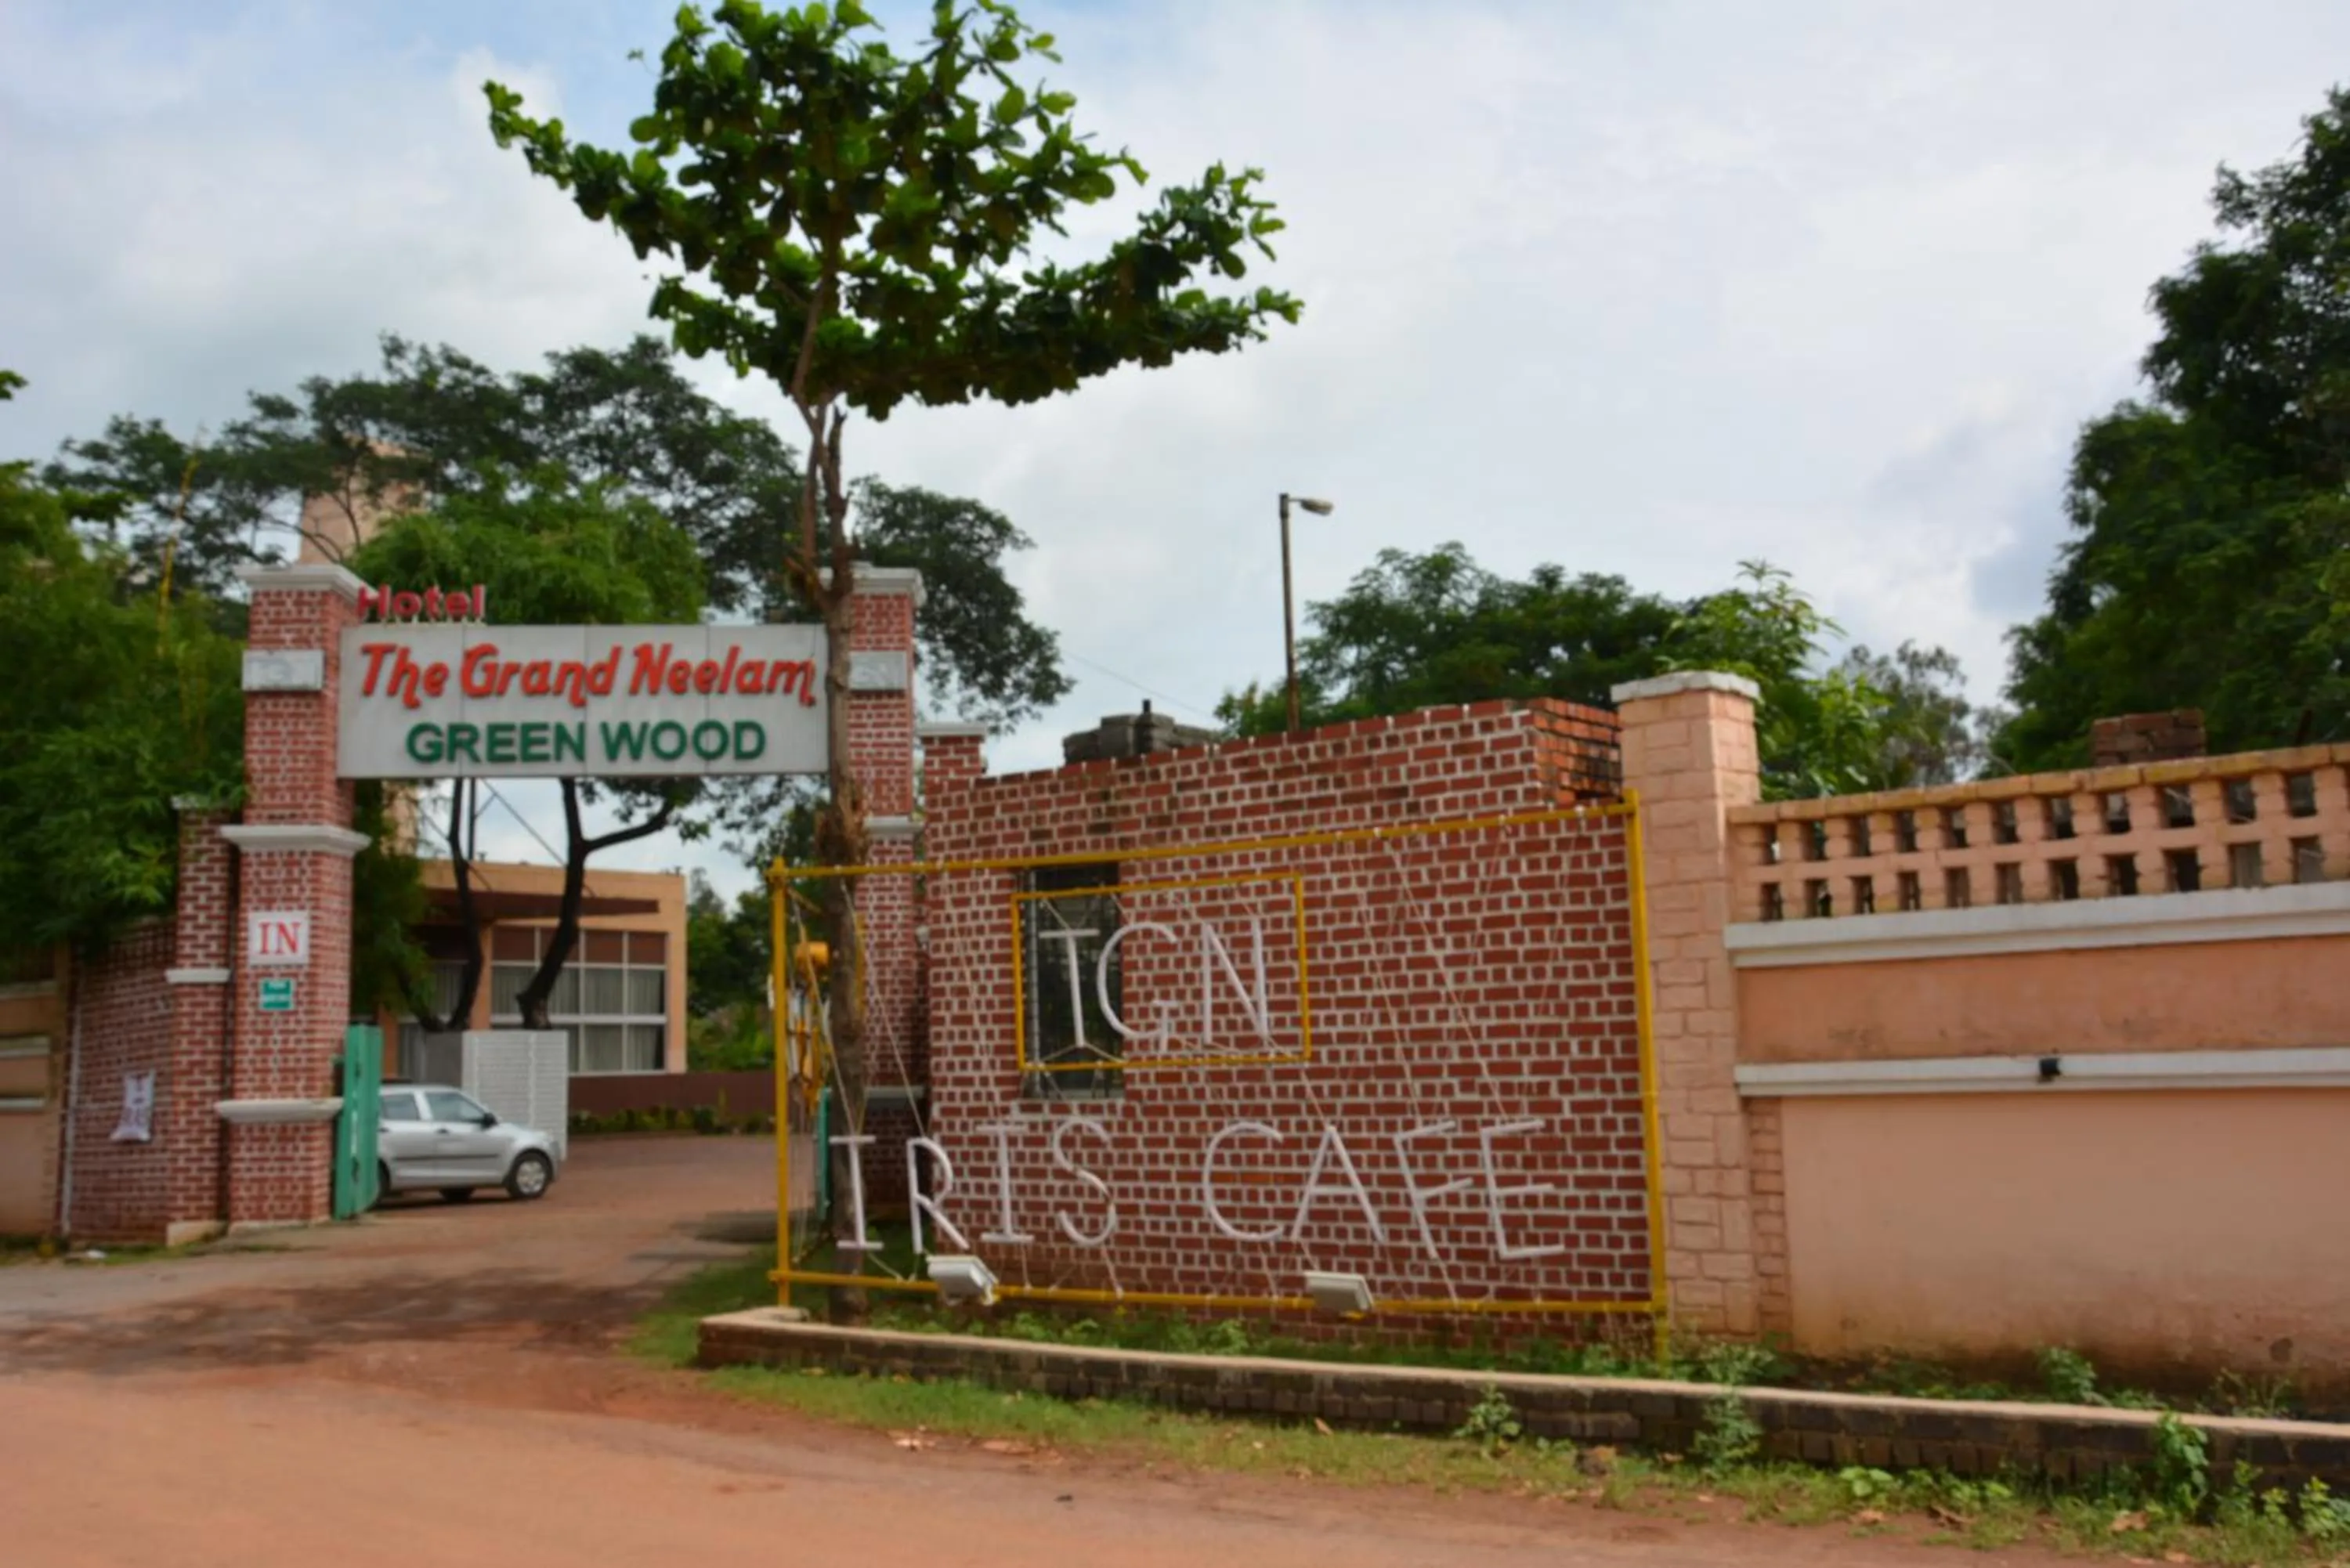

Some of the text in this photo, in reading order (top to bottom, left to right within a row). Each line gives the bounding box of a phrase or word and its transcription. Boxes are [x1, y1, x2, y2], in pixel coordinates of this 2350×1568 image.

[357, 582, 485, 621] Hotel
[360, 641, 816, 709] The Grand Neelam
[405, 720, 767, 764] GREEN WOOD
[258, 920, 302, 955] IN
[829, 1115, 1564, 1259] IRIS CAFE
